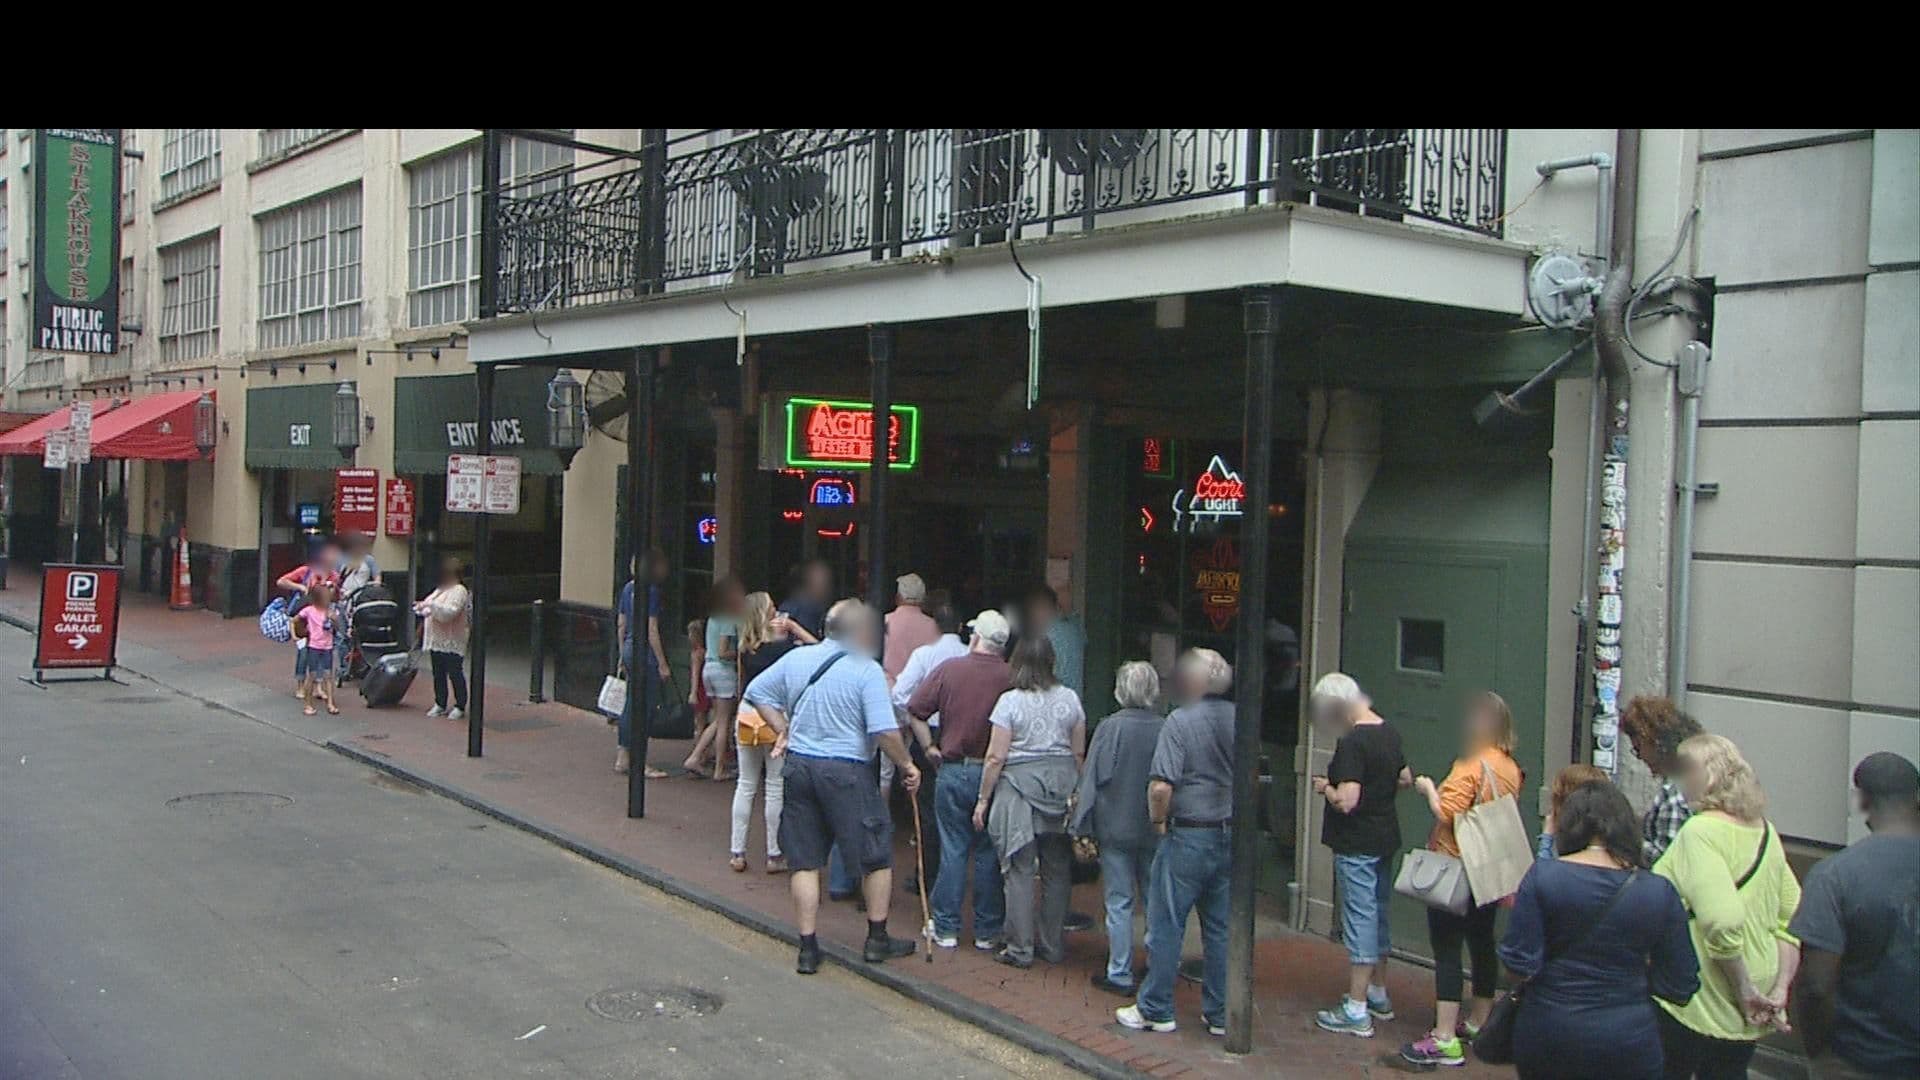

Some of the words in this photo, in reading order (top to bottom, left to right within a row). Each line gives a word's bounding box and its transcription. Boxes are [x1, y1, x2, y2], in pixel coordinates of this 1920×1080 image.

[68, 145, 91, 300] STEAKHOUSE
[52, 306, 103, 331] PUBLIC
[41, 327, 111, 352] PARKING
[290, 424, 311, 446] EXIT
[1205, 499, 1239, 511] LIGHT
[54, 624, 103, 633] GARAGE
[61, 613, 98, 623] VALET
